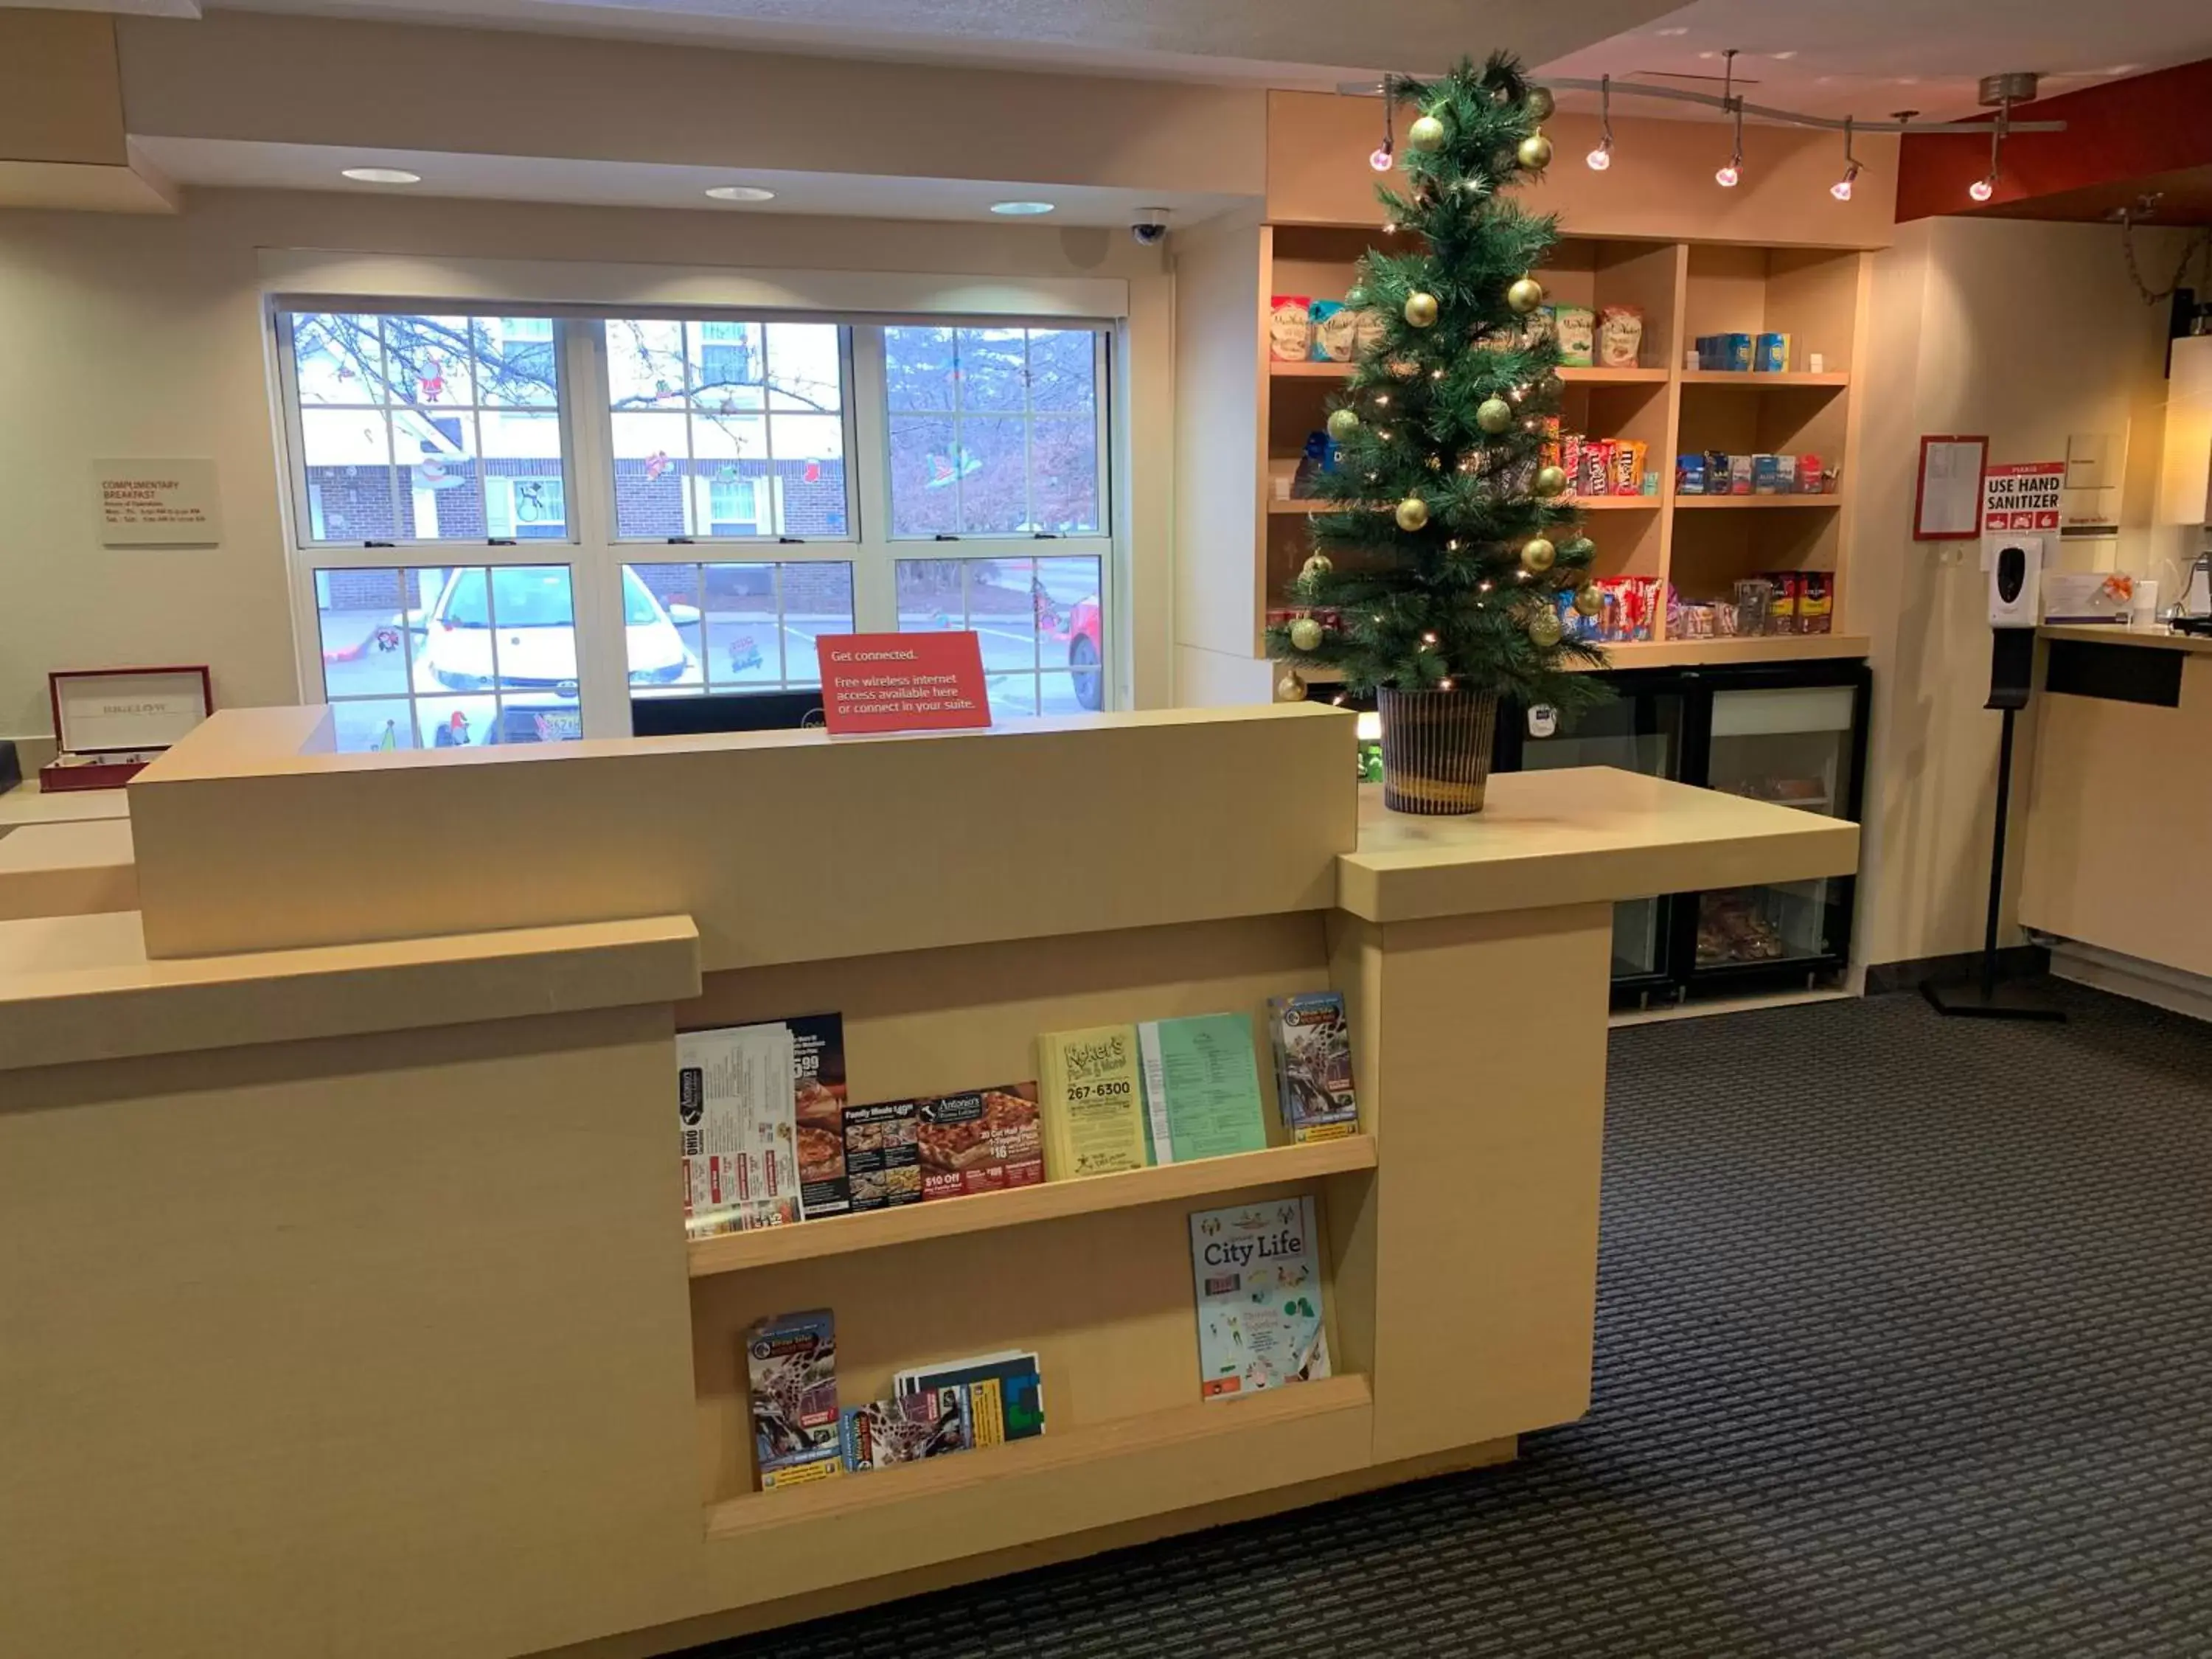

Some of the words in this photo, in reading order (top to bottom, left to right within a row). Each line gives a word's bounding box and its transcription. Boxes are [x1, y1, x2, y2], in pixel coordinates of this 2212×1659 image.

[1989, 479, 2014, 493] USE
[2018, 477, 2059, 492] HAND
[103, 490, 155, 499] BREAKFAST
[1987, 494, 2059, 510] SANITIZER
[831, 650, 852, 662] Get
[855, 648, 919, 661] connected.
[834, 676, 860, 688] Free
[862, 675, 911, 687] wireless
[912, 673, 957, 685] internet
[837, 690, 876, 701] access
[878, 687, 931, 700] available
[933, 686, 959, 697] here
[838, 704, 852, 714] or
[854, 700, 900, 714] connect
[901, 699, 914, 711] in
[915, 701, 942, 715] your
[944, 698, 975, 709] suite.
[1067, 1081, 1131, 1101] 267-6300
[940, 1096, 980, 1110] Antonio's
[846, 1109, 870, 1119] Family
[686, 1130, 698, 1156] OHIO
[925, 1176, 943, 1187] $10
[944, 1172, 960, 1184] Off
[1204, 1242, 1254, 1267] City
[1257, 1229, 1301, 1258] Life
